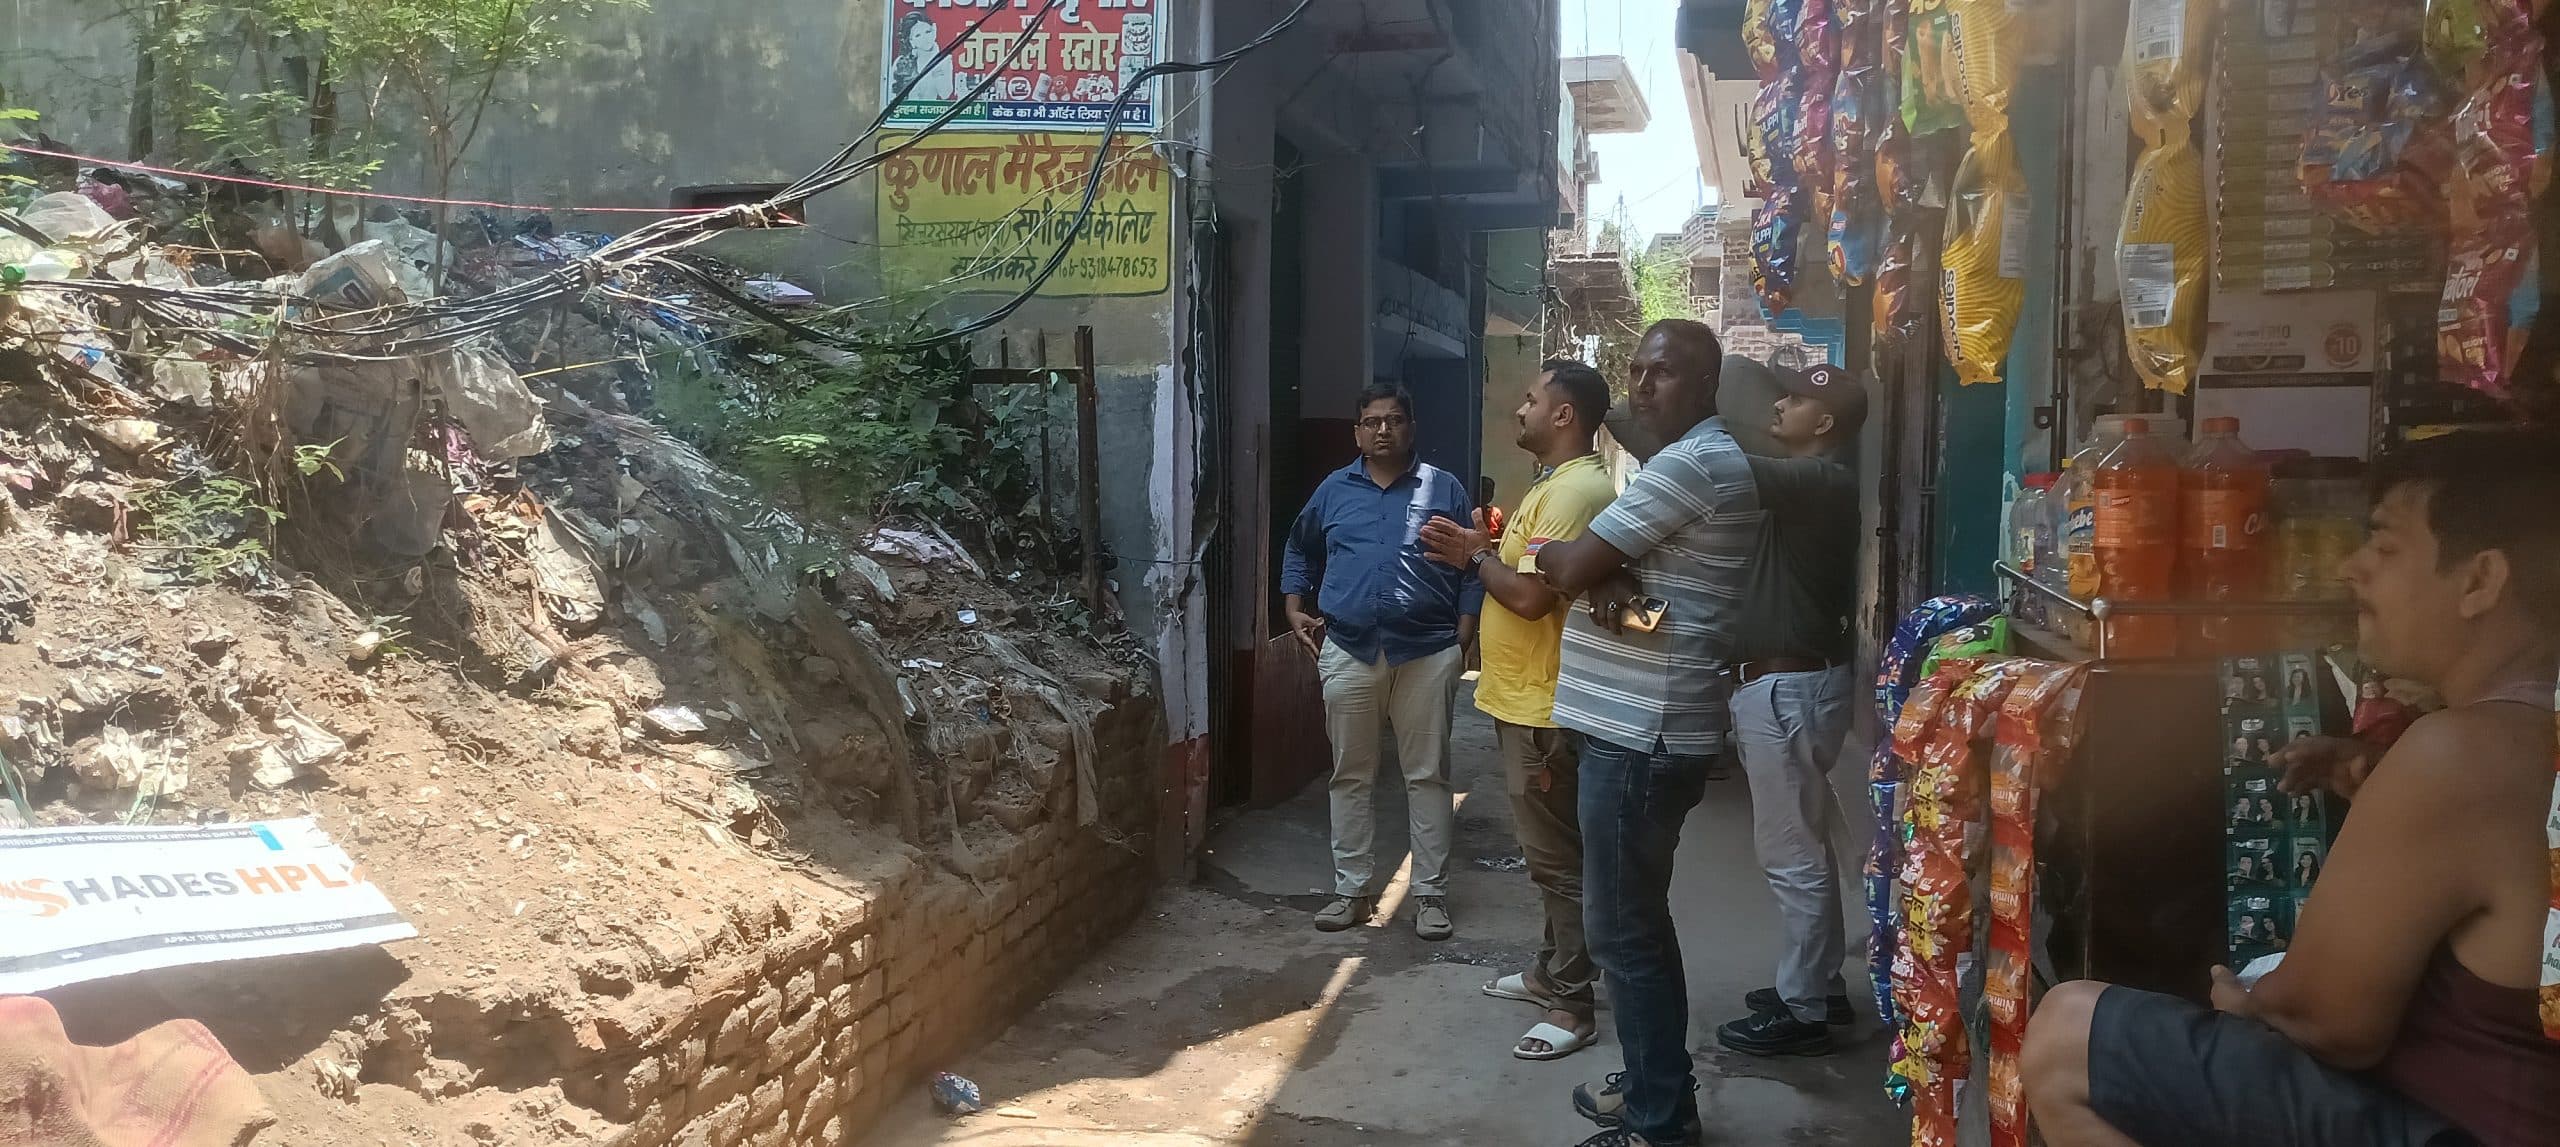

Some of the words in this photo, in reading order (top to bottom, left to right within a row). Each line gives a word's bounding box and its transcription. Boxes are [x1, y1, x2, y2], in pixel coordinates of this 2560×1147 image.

[1059, 21, 1120, 72] स्टोर
[992, 105, 1014, 117] केक
[1016, 108, 1030, 117] का
[1033, 105, 1046, 118] भी
[164, 935, 196, 944] APPLY
[199, 933, 220, 943] THE
